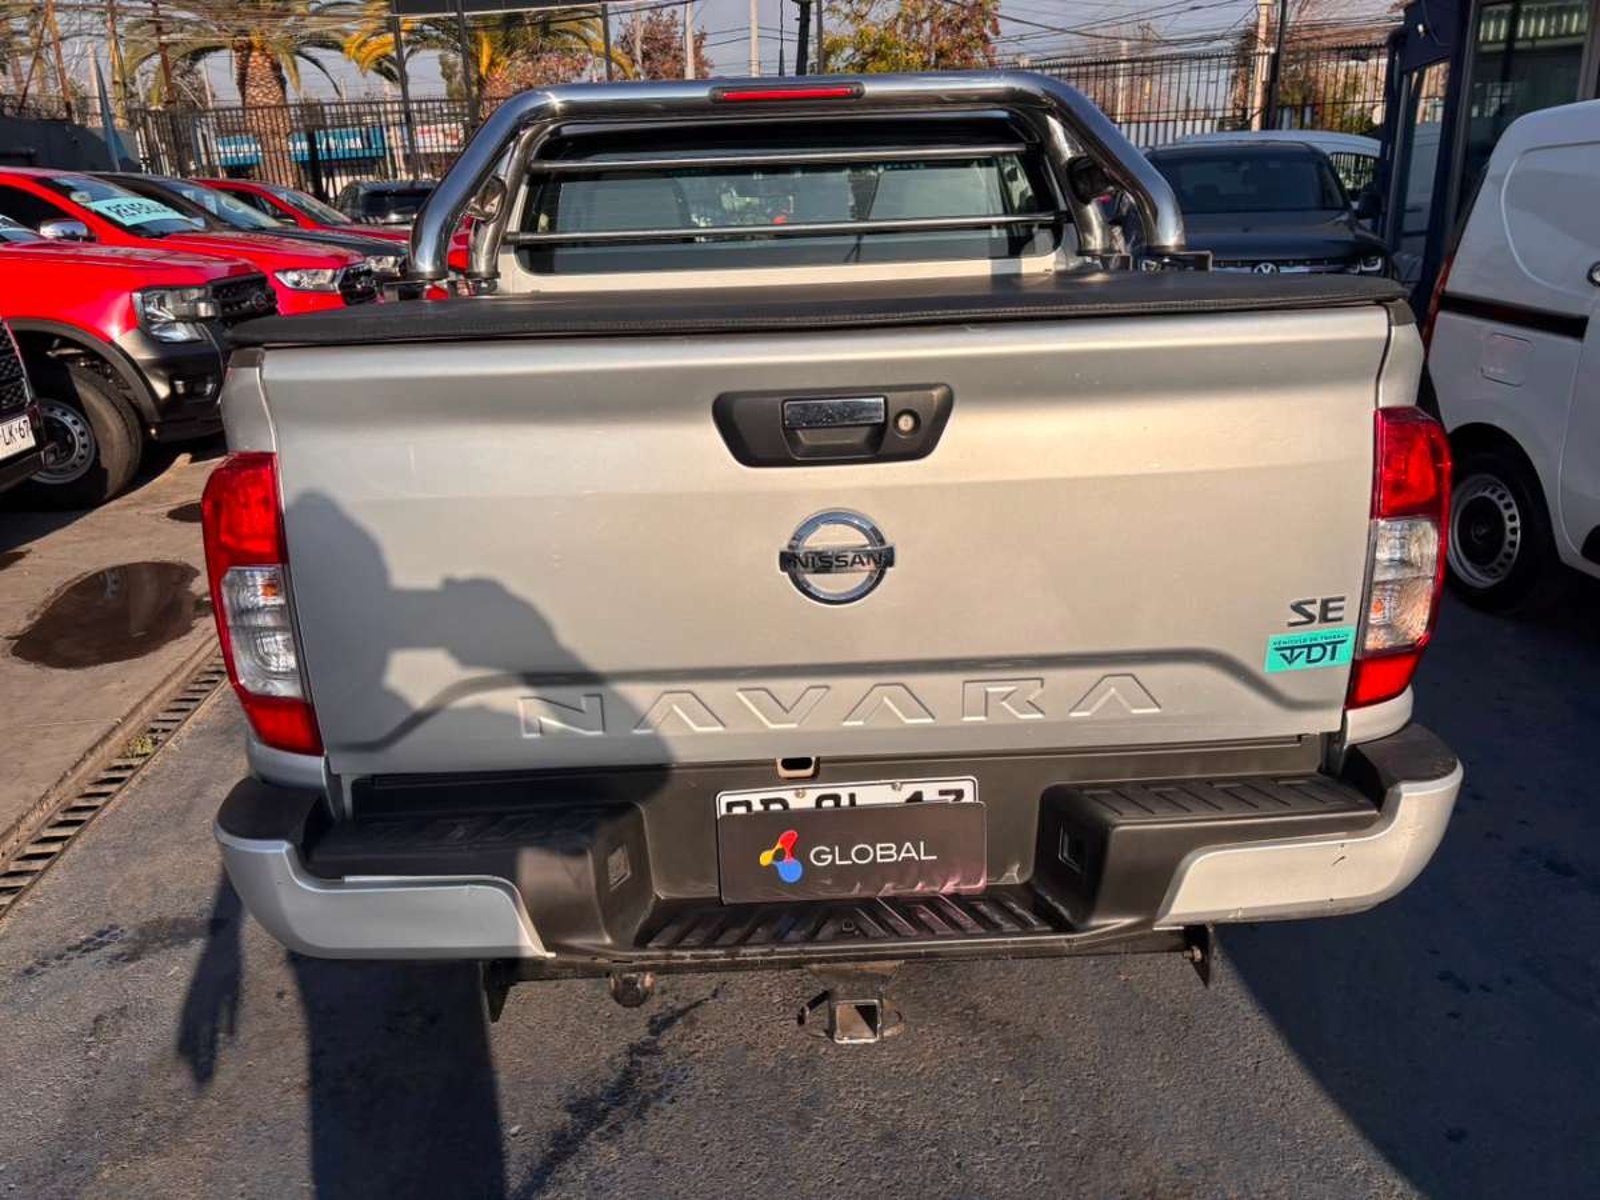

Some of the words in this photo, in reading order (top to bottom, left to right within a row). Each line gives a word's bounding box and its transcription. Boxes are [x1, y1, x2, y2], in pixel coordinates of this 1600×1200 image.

[792, 550, 882, 569] NISSAN
[1287, 596, 1345, 627] SE
[519, 673, 1162, 738] NAVARA
[810, 841, 937, 867] GLOBAL
